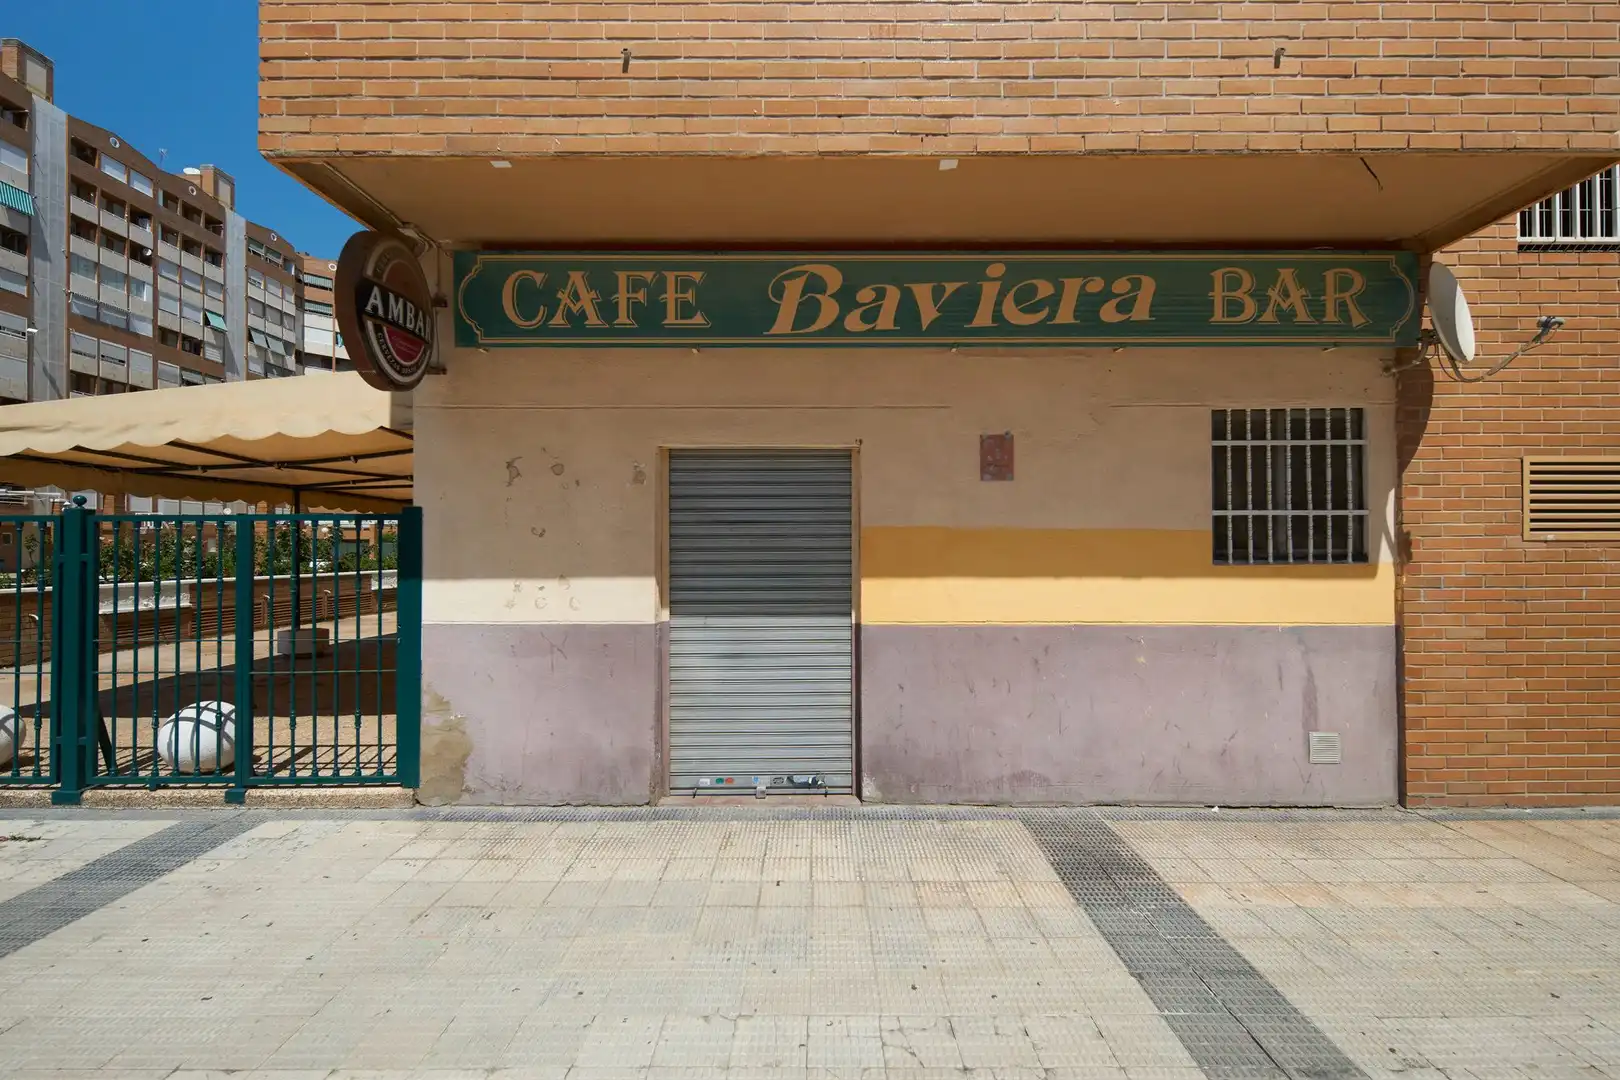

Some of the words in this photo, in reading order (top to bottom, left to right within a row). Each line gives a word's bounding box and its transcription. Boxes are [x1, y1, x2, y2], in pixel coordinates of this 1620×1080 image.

[502, 269, 712, 329] CAFE
[762, 262, 1157, 335] Baviera
[1208, 266, 1372, 329] BAR
